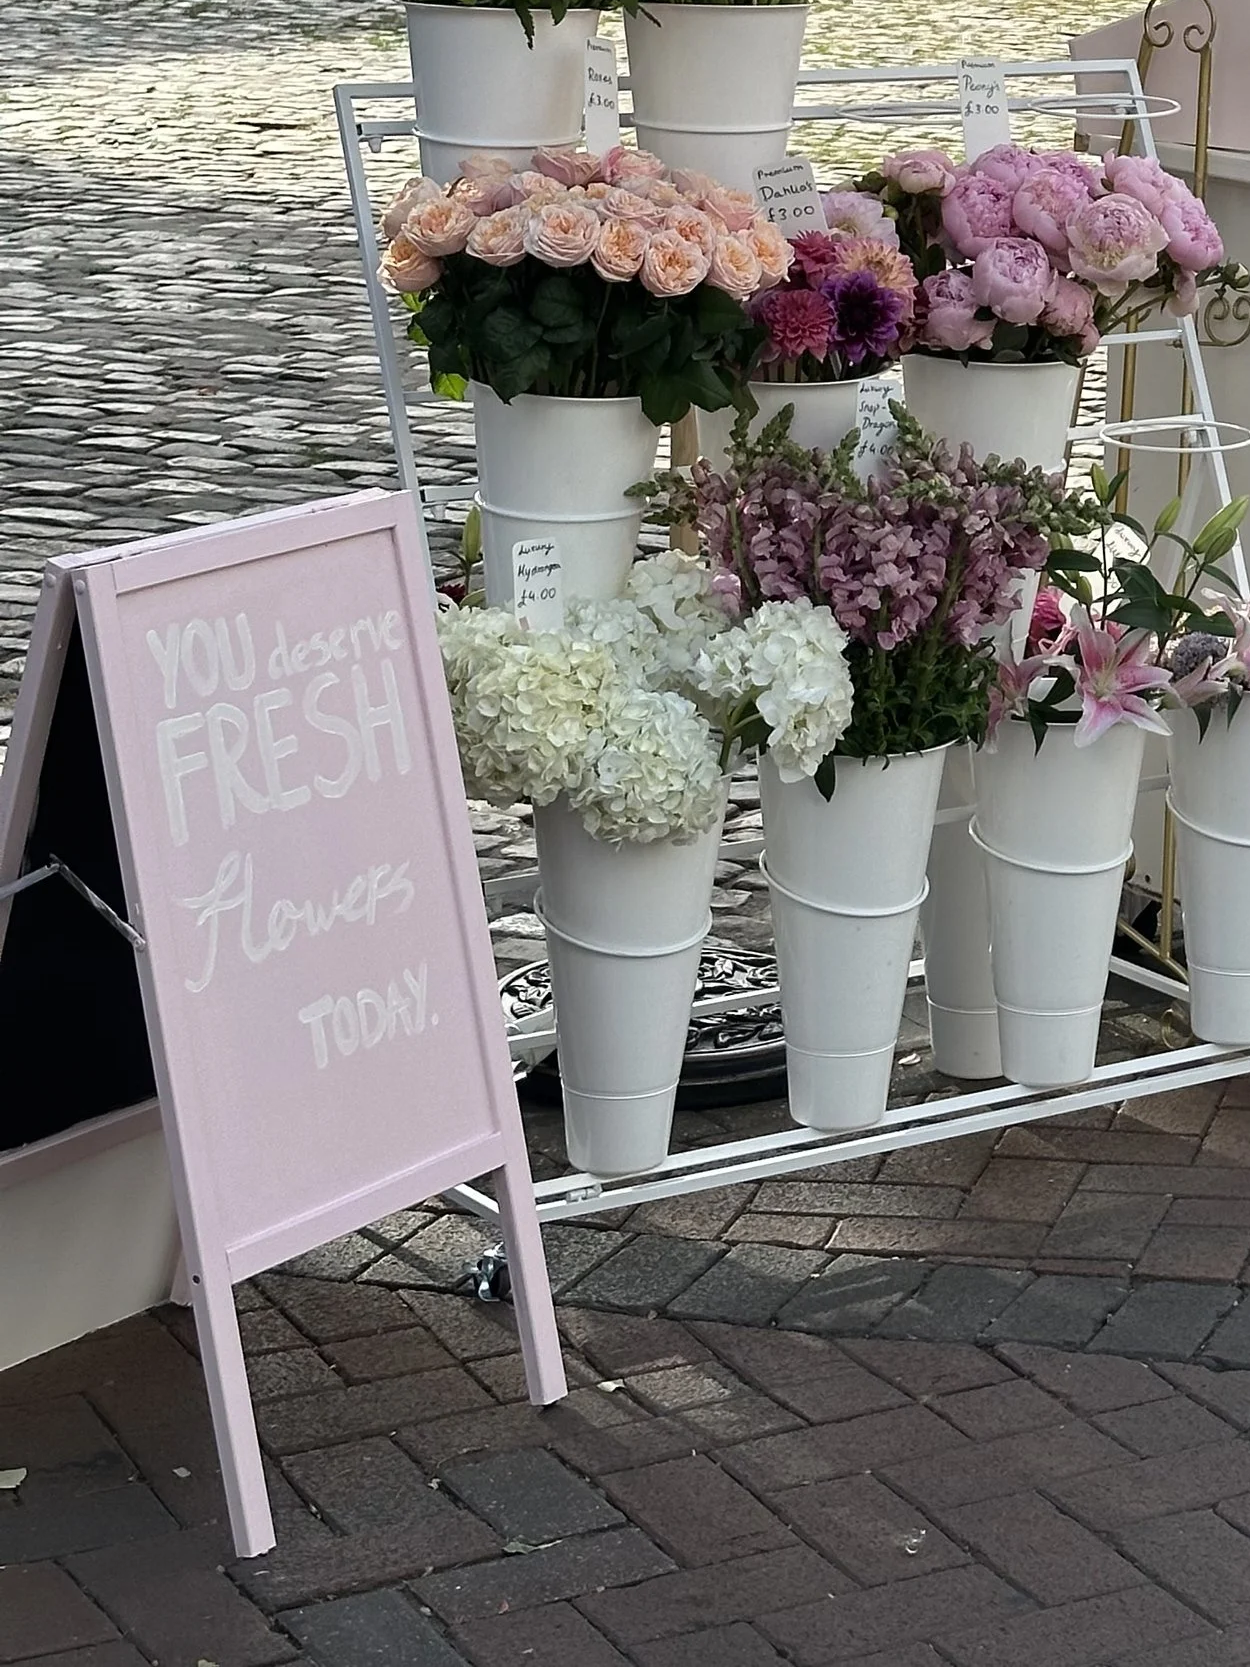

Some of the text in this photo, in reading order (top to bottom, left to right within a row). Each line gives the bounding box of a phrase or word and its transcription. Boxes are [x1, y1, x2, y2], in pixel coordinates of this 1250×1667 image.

[588, 66, 613, 85] Roses
[517, 586, 557, 609] £4.00
[146, 609, 402, 710] YOU deserve
[156, 658, 412, 848] FRESH
